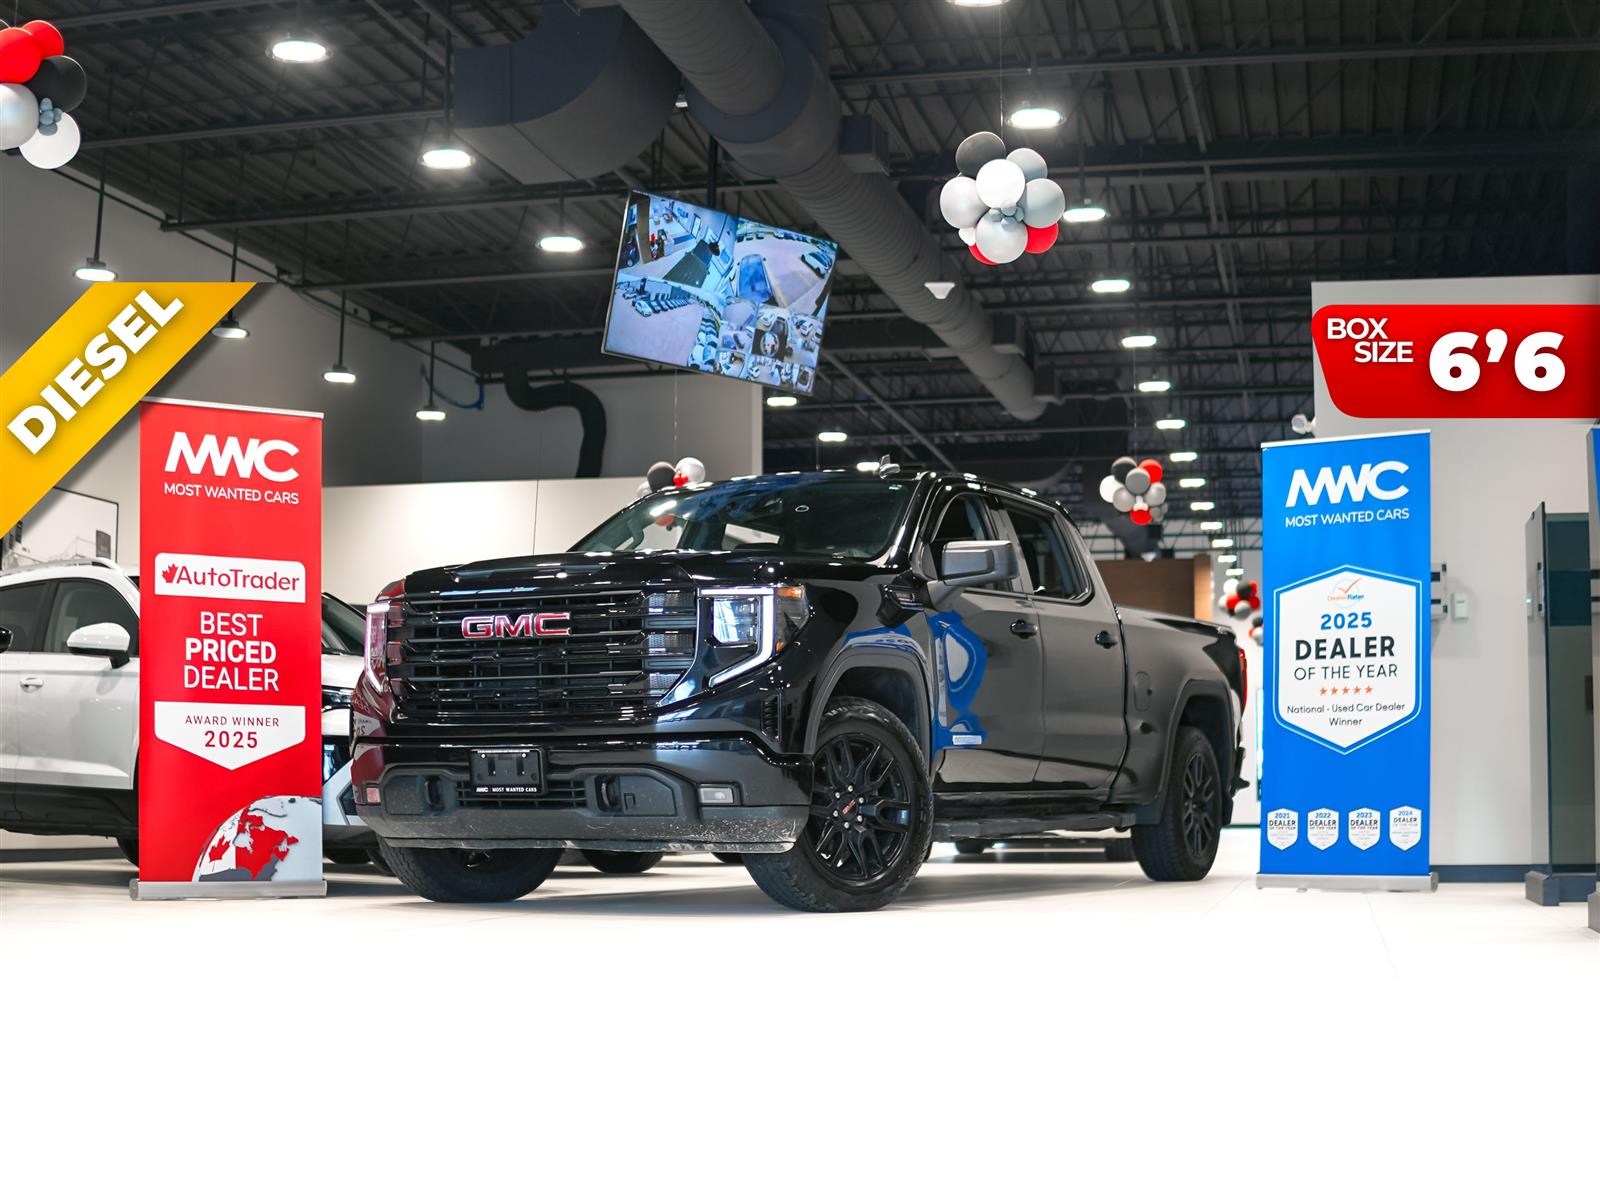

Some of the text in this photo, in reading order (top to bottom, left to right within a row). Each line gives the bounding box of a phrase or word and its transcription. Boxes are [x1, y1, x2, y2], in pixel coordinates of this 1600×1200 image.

[165, 432, 299, 482] MWC
[165, 483, 298, 504] MOST WANTED CARS
[1286, 461, 1408, 509] MWC
[1286, 508, 1409, 527] MOST WANTED CARS
[176, 565, 300, 591] AutoTrader
[201, 612, 263, 636] BEST
[461, 612, 570, 639] GMC
[1321, 612, 1371, 630] 2025
[185, 637, 277, 665] PRICED
[1296, 636, 1394, 660] DEALER
[184, 665, 278, 691] DEALER
[1294, 664, 1397, 680] OF THE YEAR
[1287, 704, 1325, 714] National
[1332, 704, 1355, 713] Used
[1356, 703, 1374, 712] Car
[1376, 702, 1405, 711] Dealer
[186, 716, 278, 726] AWARD WINNER
[1328, 718, 1362, 726] Winner
[205, 731, 257, 748] 2025
